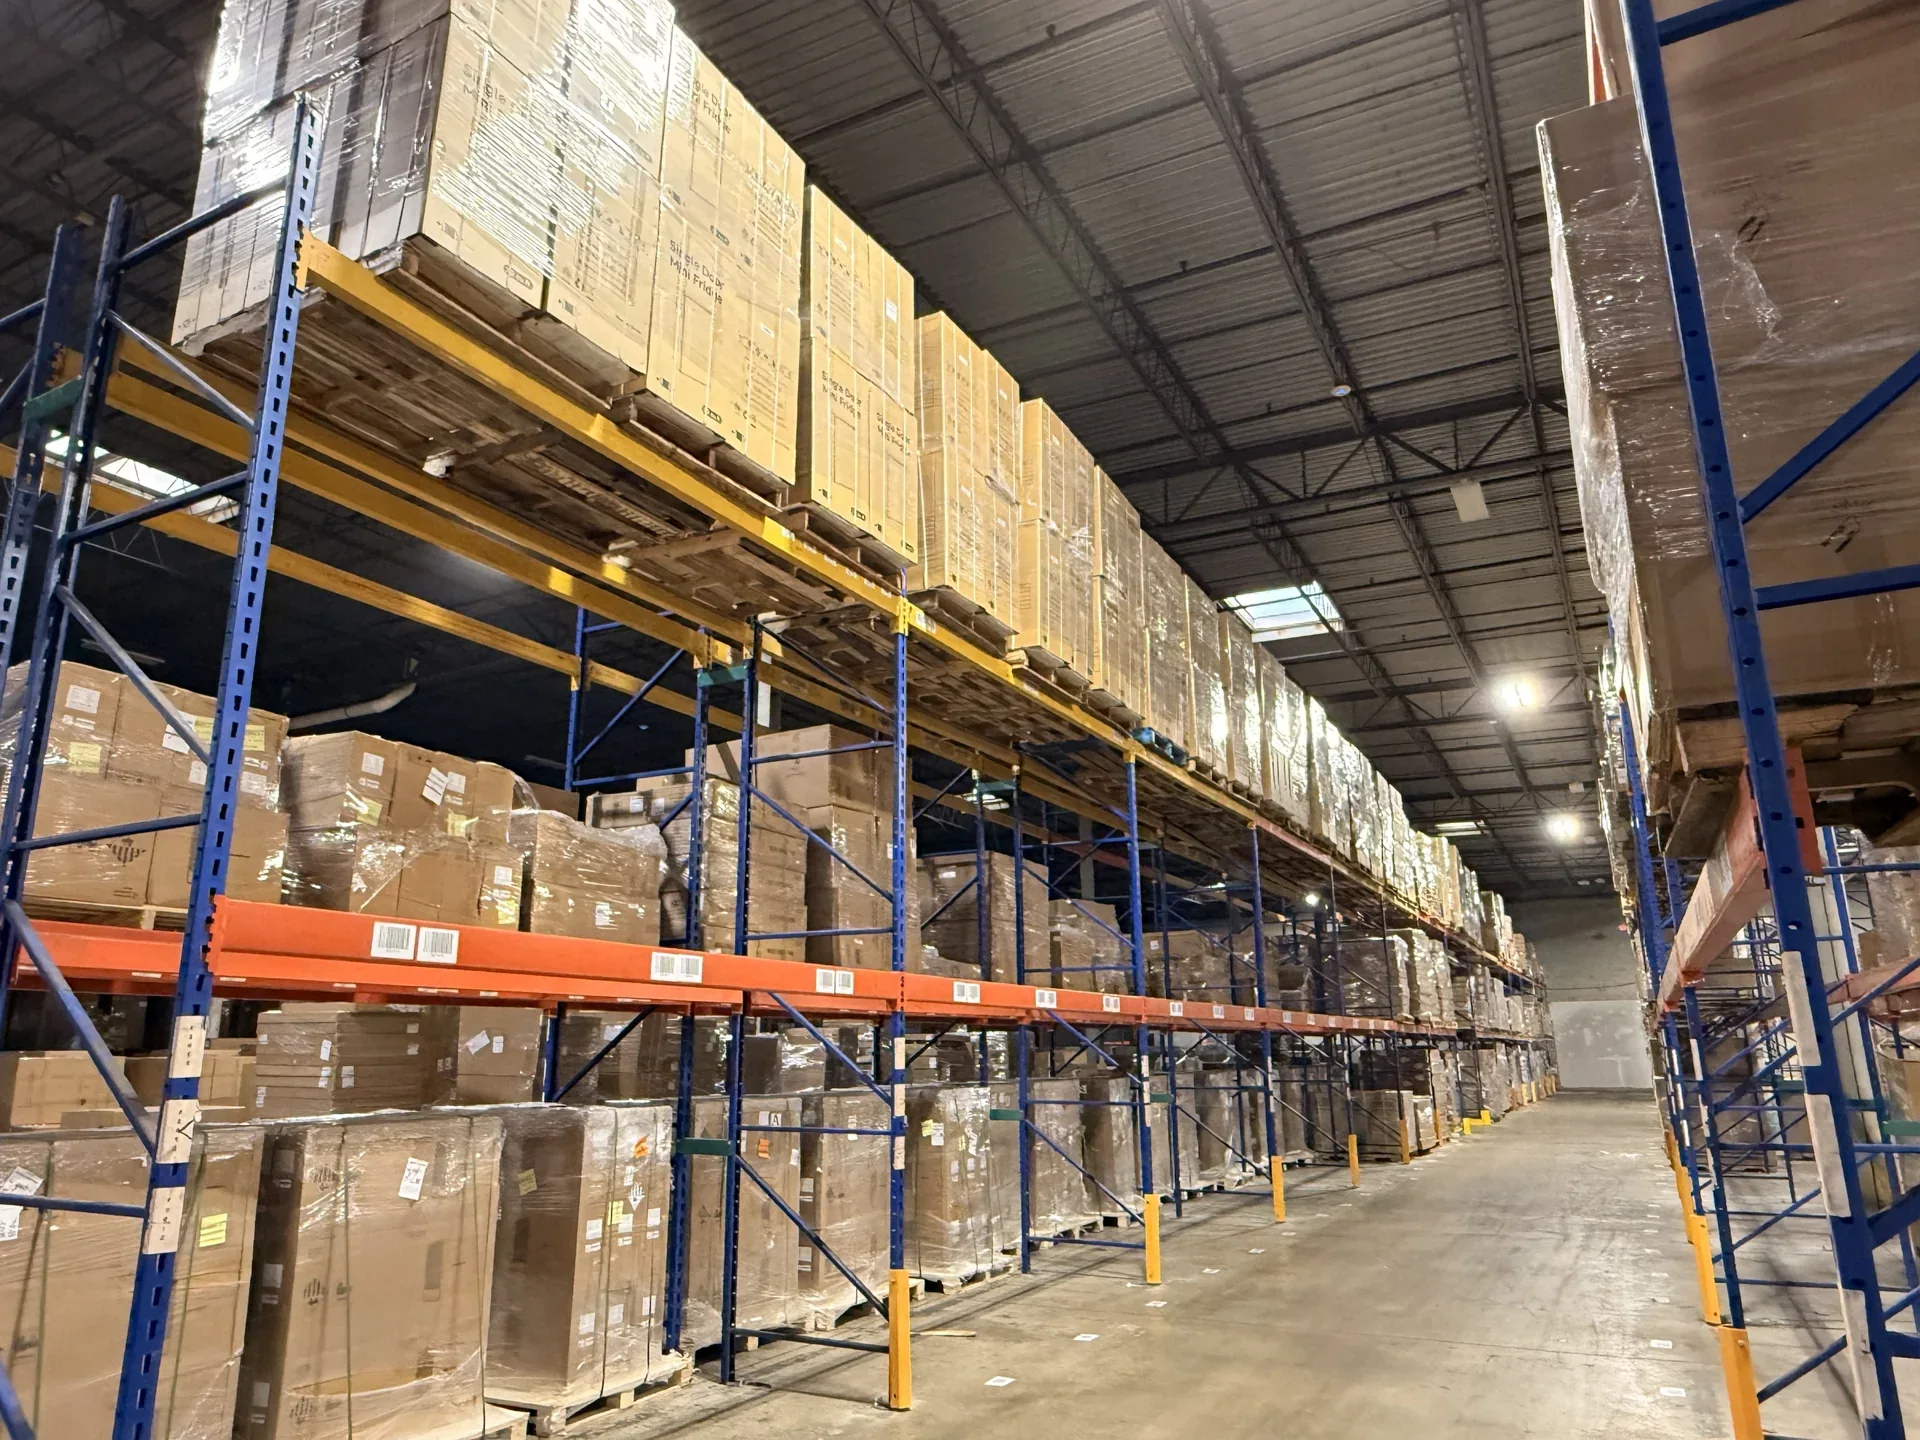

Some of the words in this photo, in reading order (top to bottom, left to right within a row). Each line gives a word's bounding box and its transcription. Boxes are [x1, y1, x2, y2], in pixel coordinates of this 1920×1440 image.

[669, 239, 700, 271] Single
[702, 264, 724, 291] Door
[669, 256, 691, 280] Mini
[693, 273, 723, 305] Fridge
